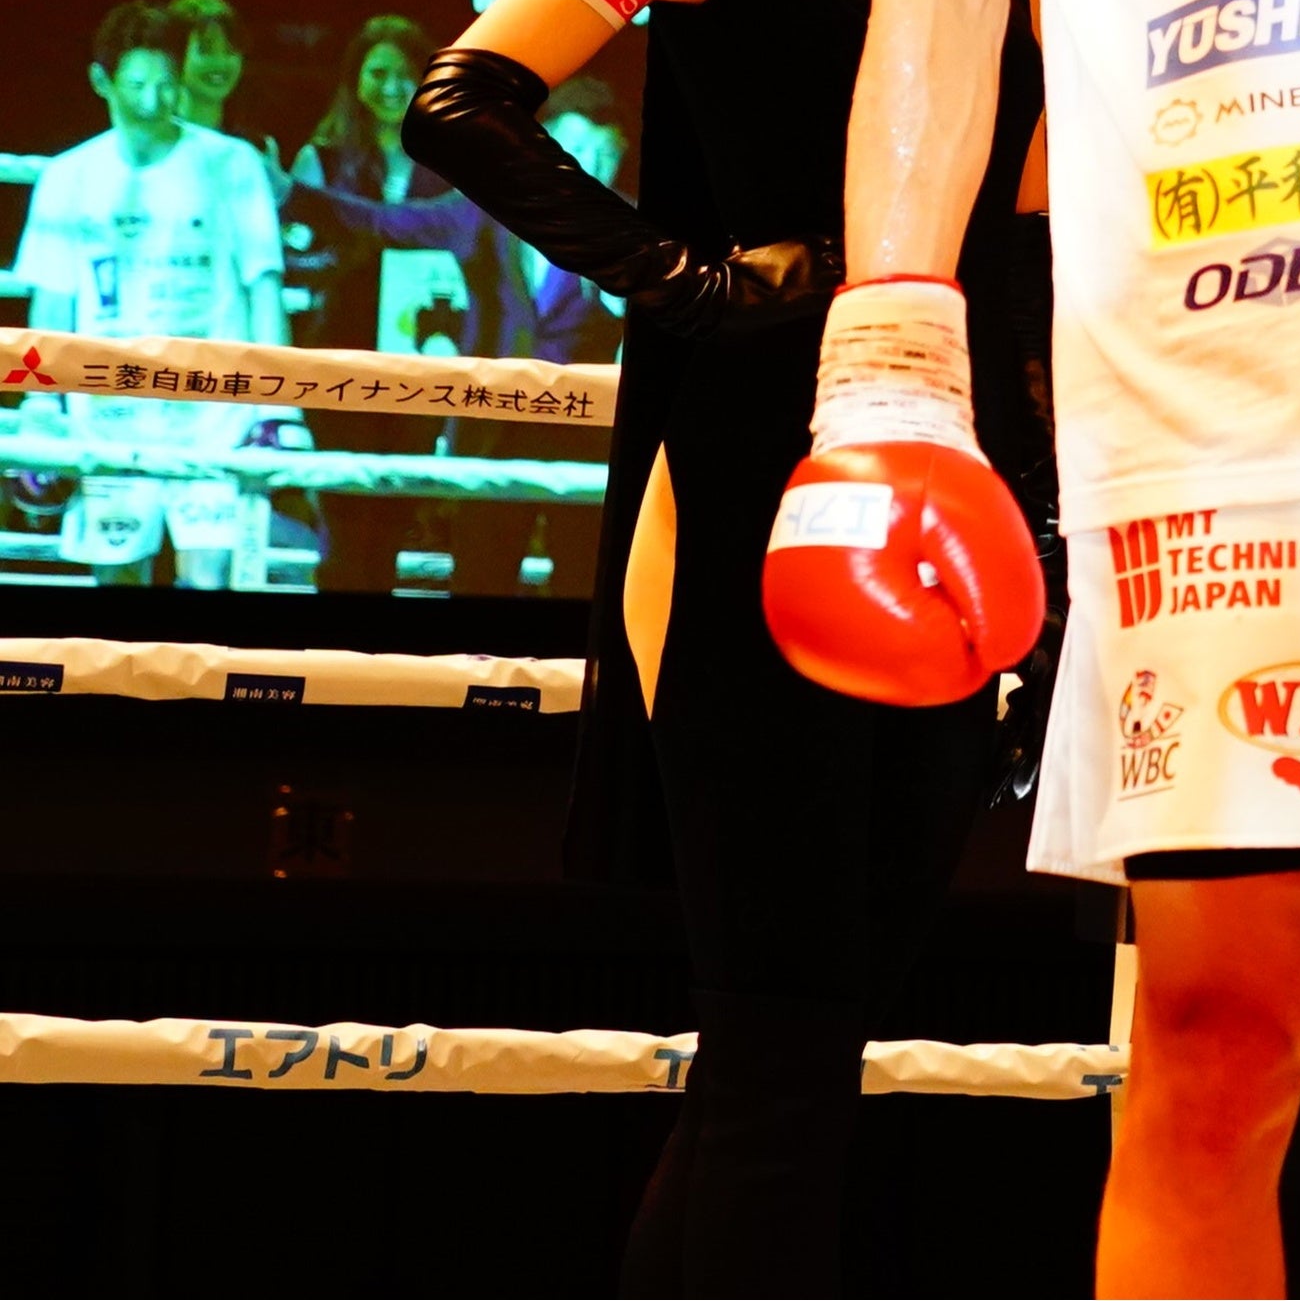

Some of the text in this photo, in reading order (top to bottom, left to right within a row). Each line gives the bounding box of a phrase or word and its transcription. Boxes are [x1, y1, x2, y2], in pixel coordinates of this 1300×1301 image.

[78, 363, 595, 421] 三菱自動車ファイナンス株式会社
[1165, 509, 1217, 540] MT
[1170, 578, 1282, 615] JAPAN
[1121, 741, 1180, 791] WBC
[199, 1029, 427, 1080] エアトリ
